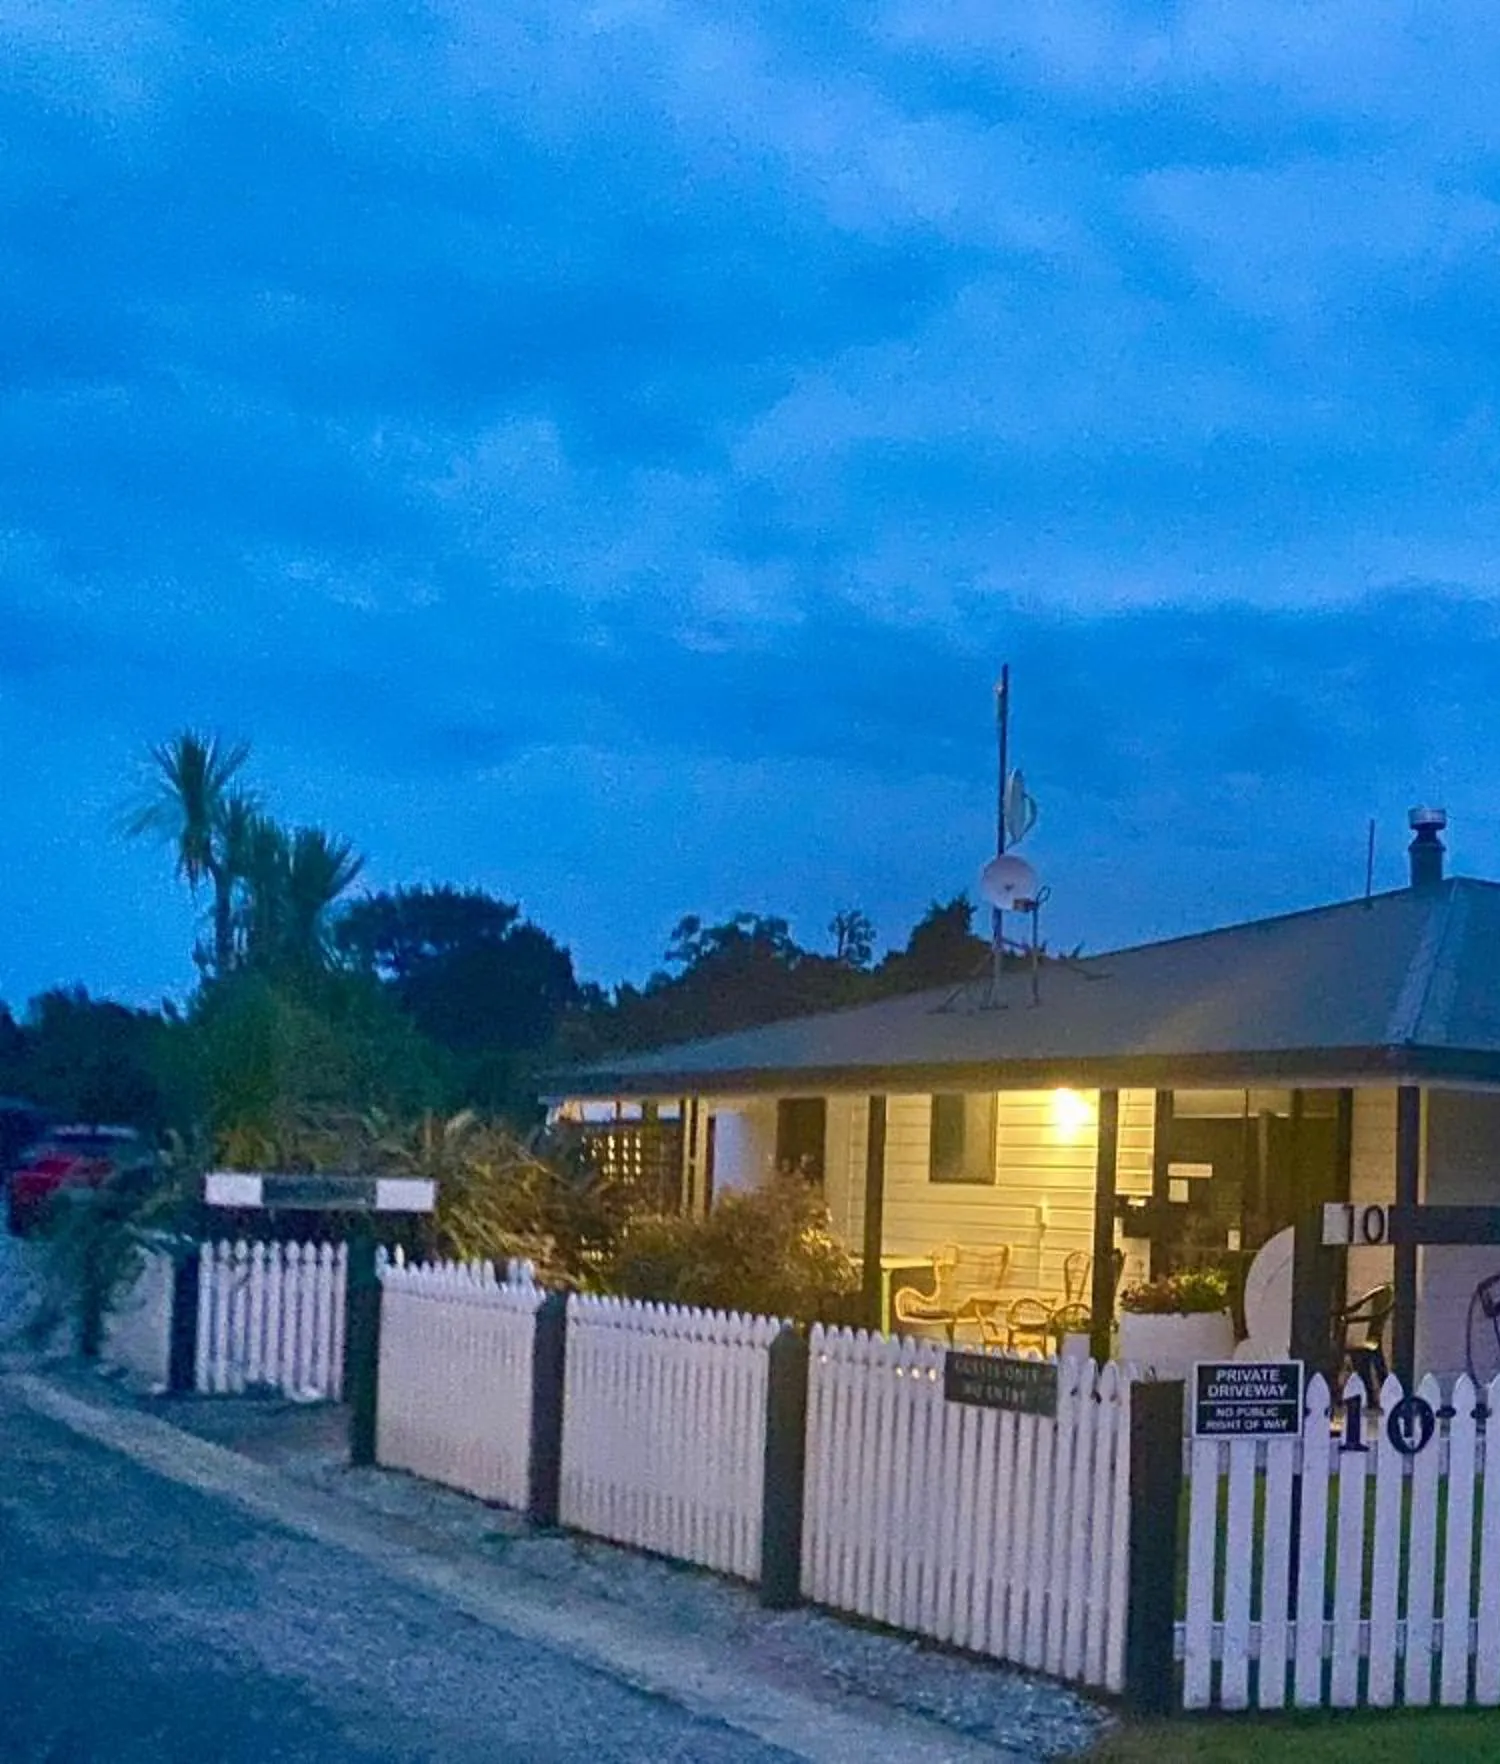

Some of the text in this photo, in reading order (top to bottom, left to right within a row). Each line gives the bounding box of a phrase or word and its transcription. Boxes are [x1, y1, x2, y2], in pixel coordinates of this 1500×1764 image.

[1342, 1204, 1385, 1244] 10
[1215, 1368, 1281, 1383] PRIVATE
[1207, 1383, 1289, 1398] DRIVEWAY
[1215, 1407, 1279, 1417] NO PUBLIC
[1205, 1418, 1288, 1430] RIGHT OF WAY
[1338, 1393, 1436, 1455] 10
